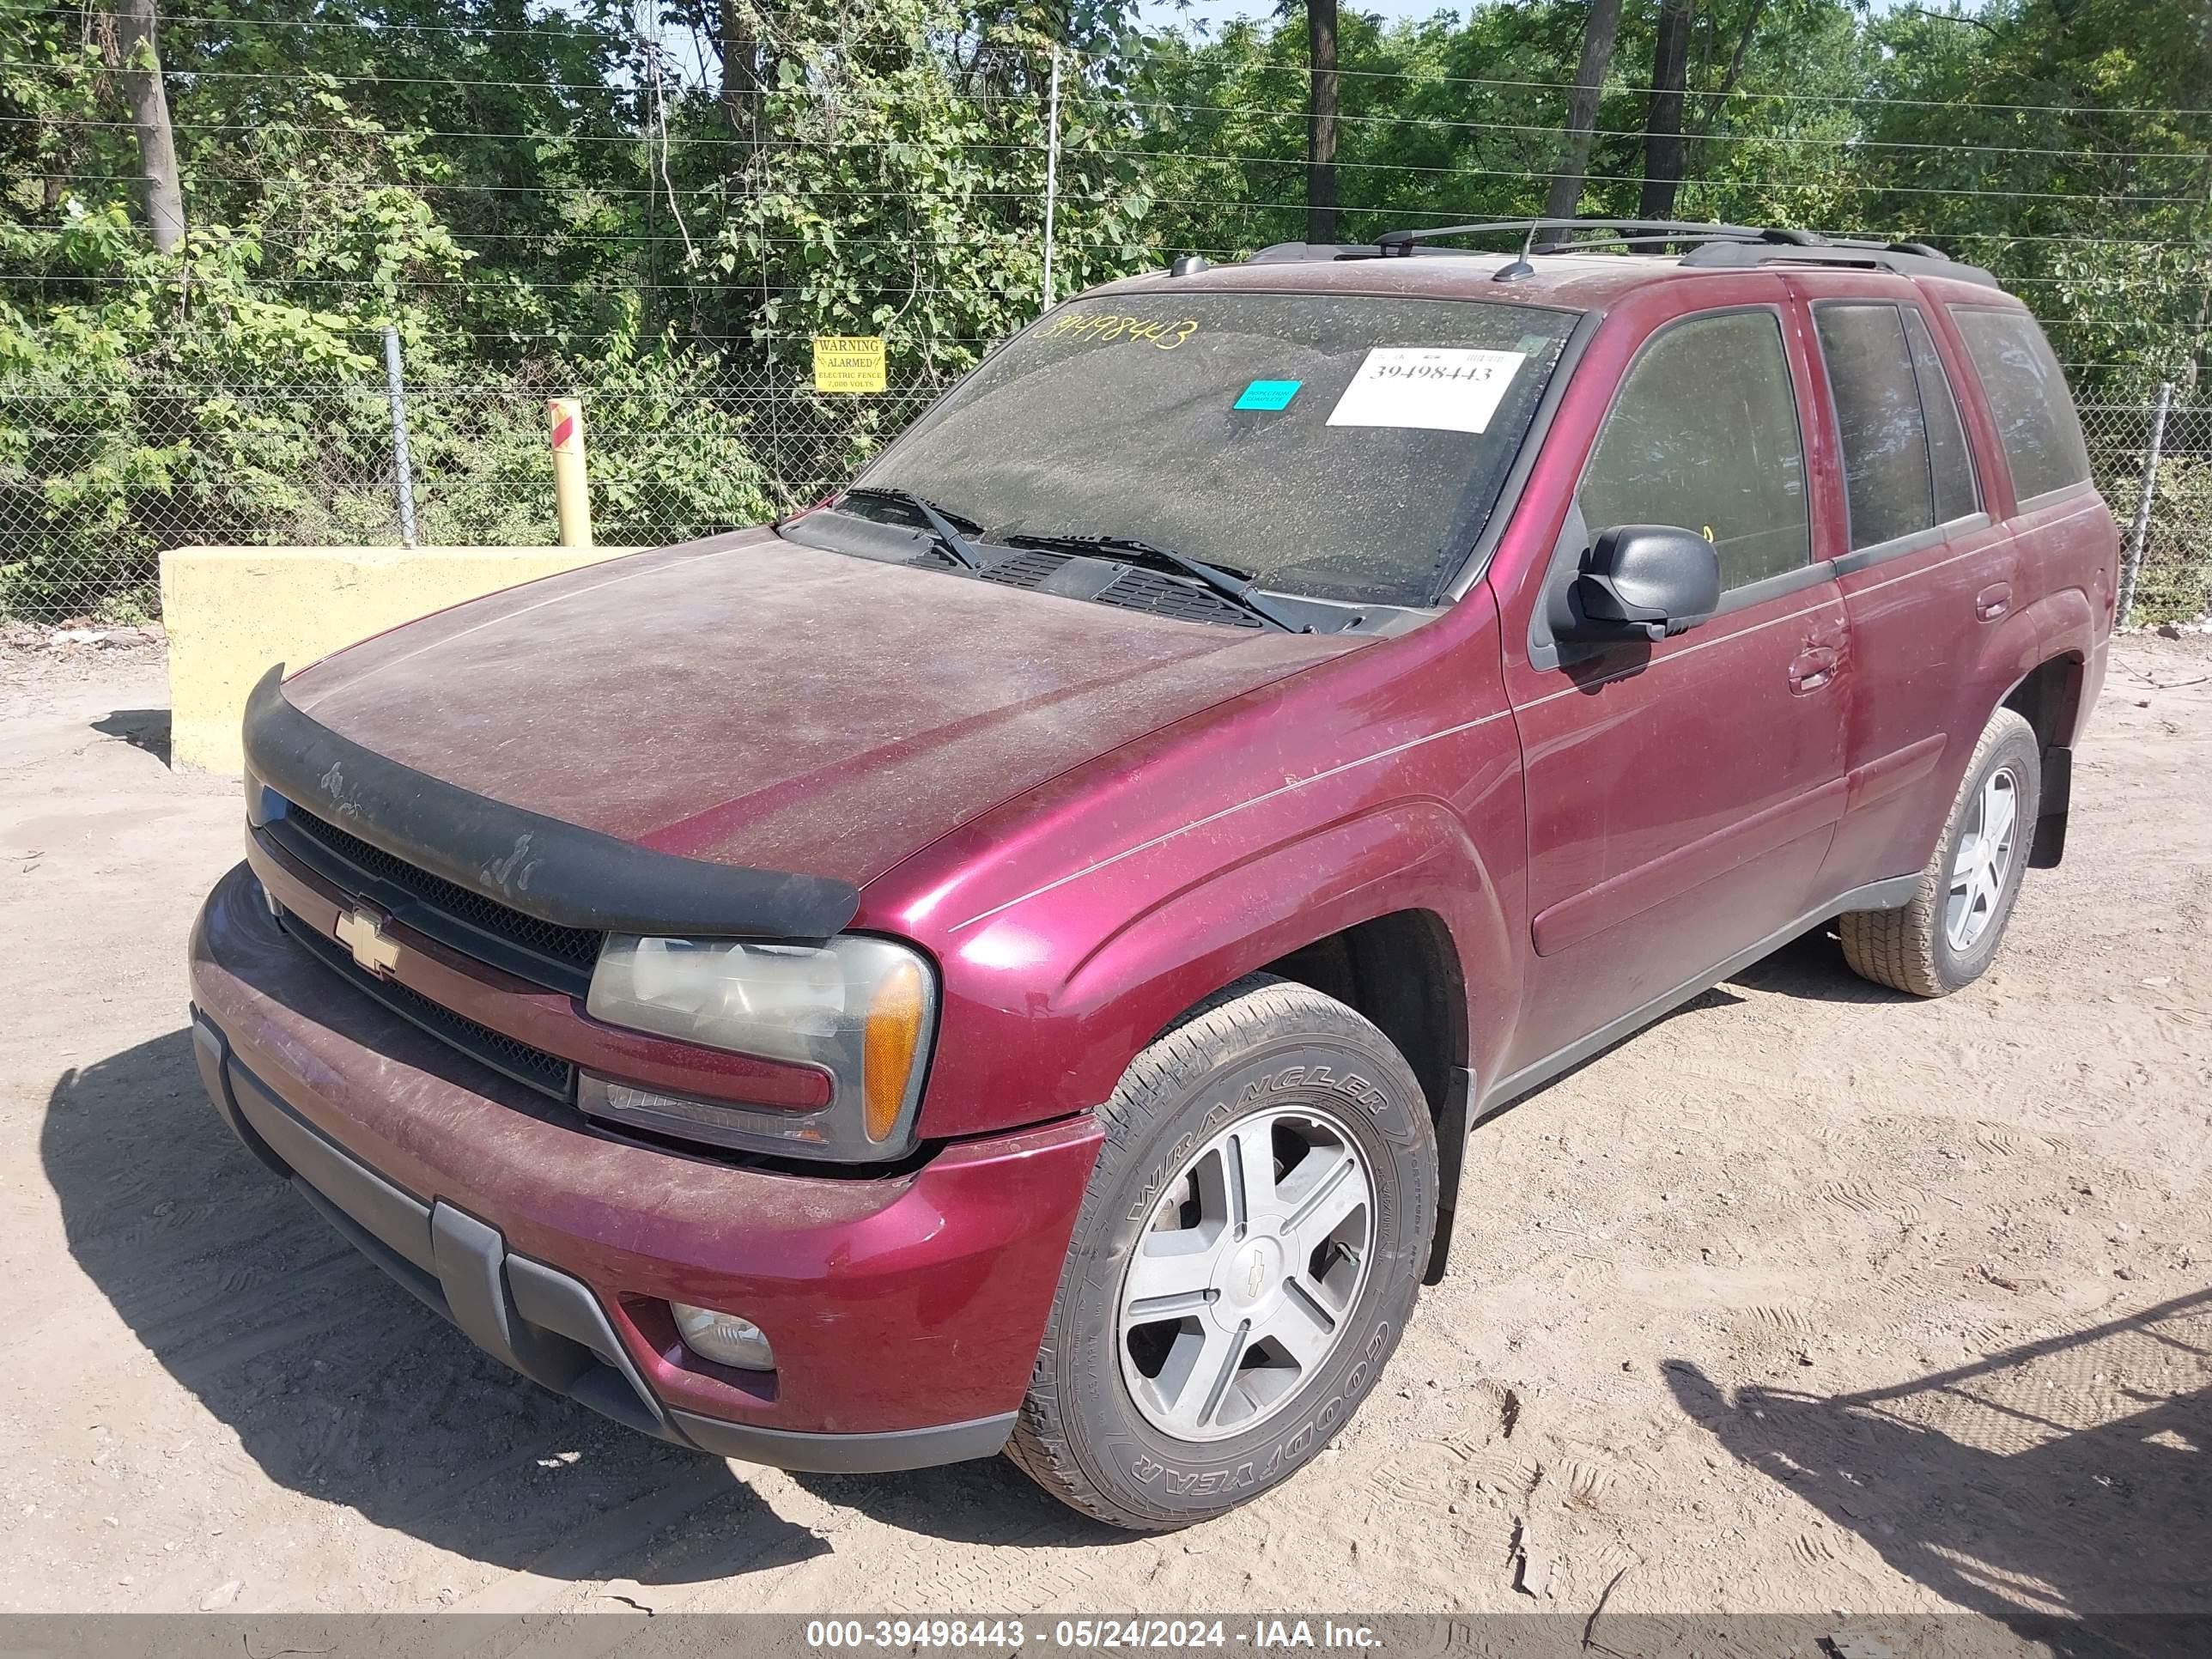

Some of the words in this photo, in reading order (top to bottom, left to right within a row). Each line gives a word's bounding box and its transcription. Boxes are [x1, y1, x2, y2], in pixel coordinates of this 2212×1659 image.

[1032, 315, 1199, 349] 39498443
[820, 340, 879, 352] WARNING
[827, 357, 872, 368] ALARMED
[1370, 366, 1492, 380] 39498443
[1127, 1065, 1389, 1222] WRANGLER
[1123, 1320, 1389, 1497] GOODYEAR
